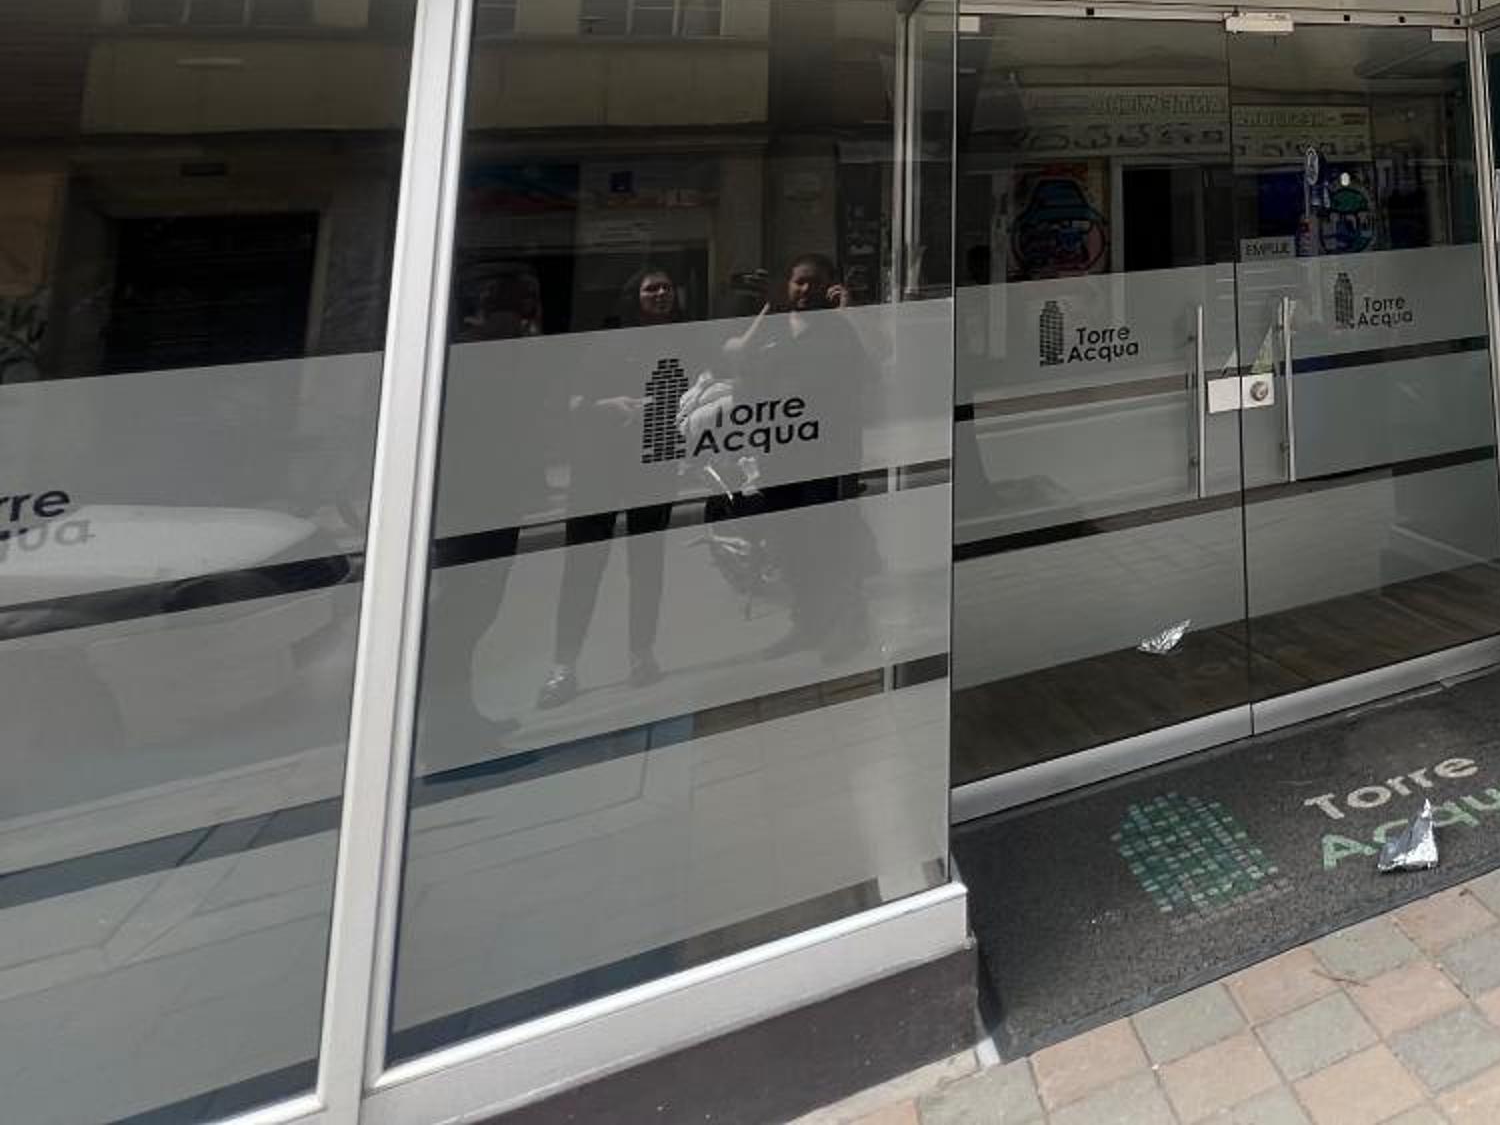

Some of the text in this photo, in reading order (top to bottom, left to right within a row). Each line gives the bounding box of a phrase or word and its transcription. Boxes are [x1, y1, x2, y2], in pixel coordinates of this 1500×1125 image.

[1363, 296, 1406, 313] Torre
[1357, 310, 1413, 328] Acqua
[1076, 326, 1131, 345] Torre
[1067, 342, 1139, 363] Acqua
[692, 420, 820, 457] Acqua
[1303, 757, 1479, 820] Torre
